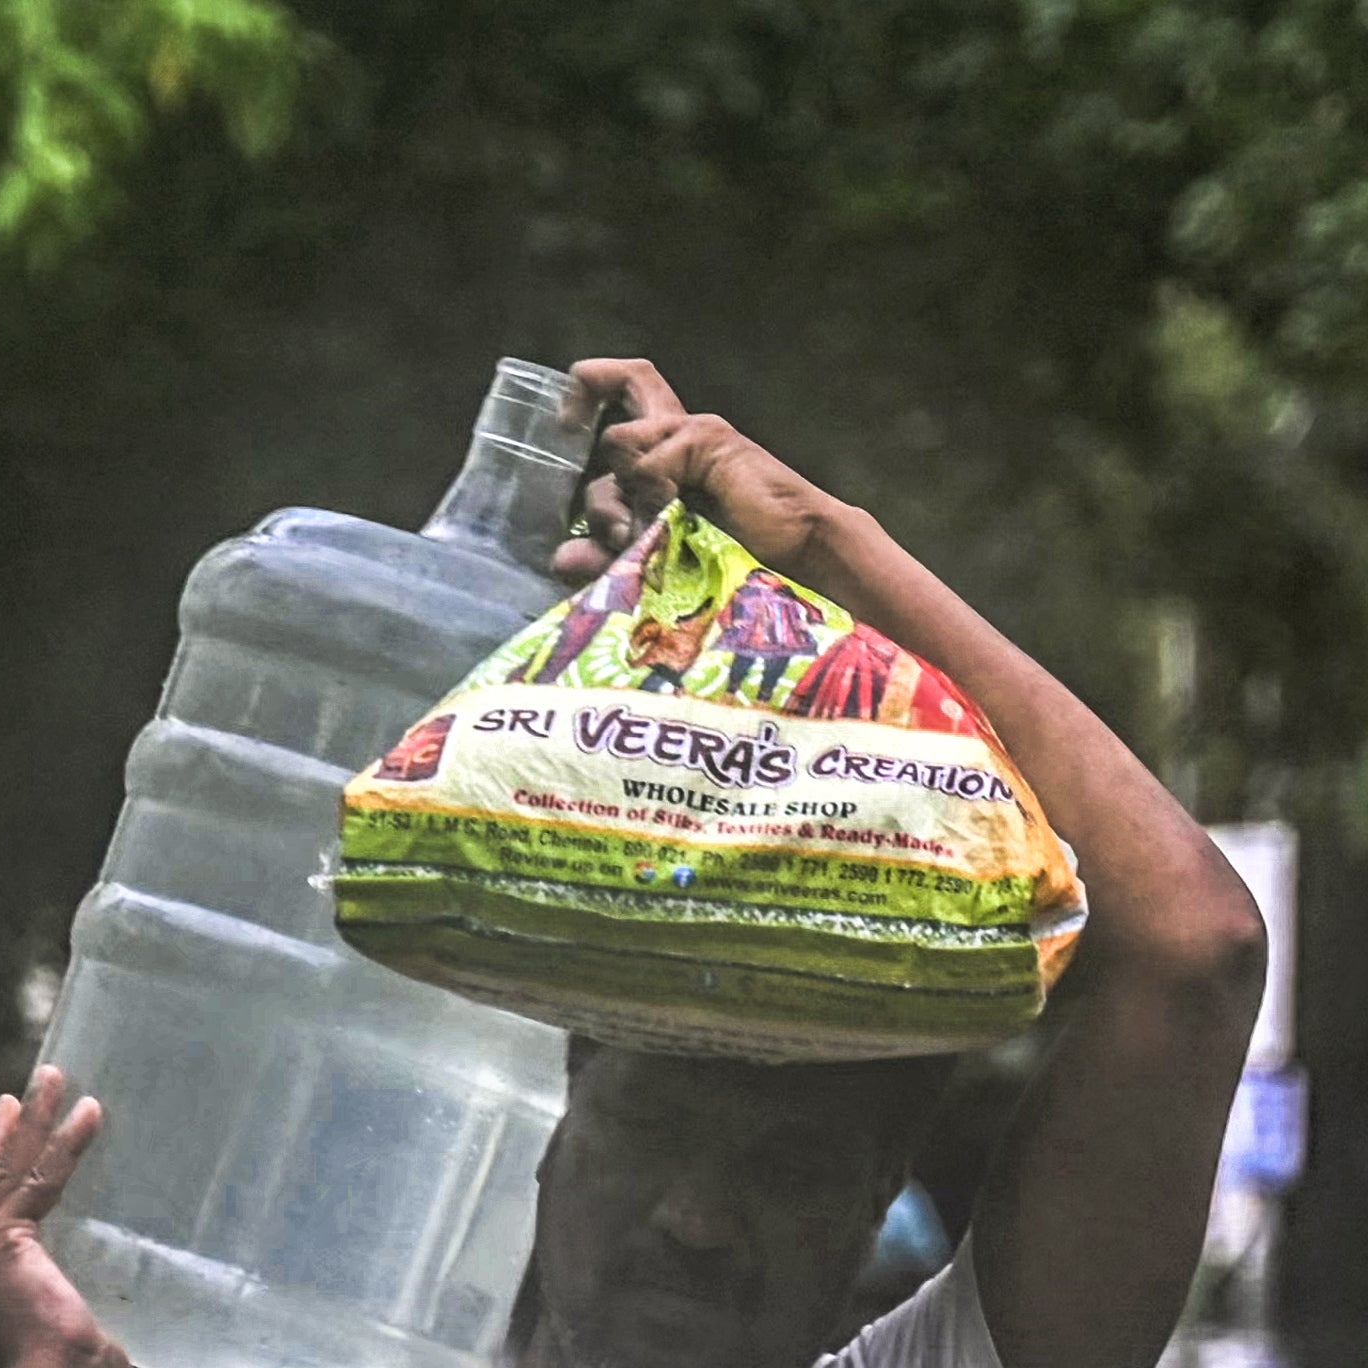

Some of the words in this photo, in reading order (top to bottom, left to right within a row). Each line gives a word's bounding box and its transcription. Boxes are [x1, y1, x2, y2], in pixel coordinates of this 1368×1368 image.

[472, 708, 556, 739] SRI
[576, 705, 796, 788] VEERA'S
[513, 788, 620, 818] Collection
[627, 806, 648, 823] of
[716, 820, 792, 838] Textiles
[797, 821, 815, 839] &
[621, 777, 777, 817] WHOLESALE
[784, 801, 858, 819] SHOP
